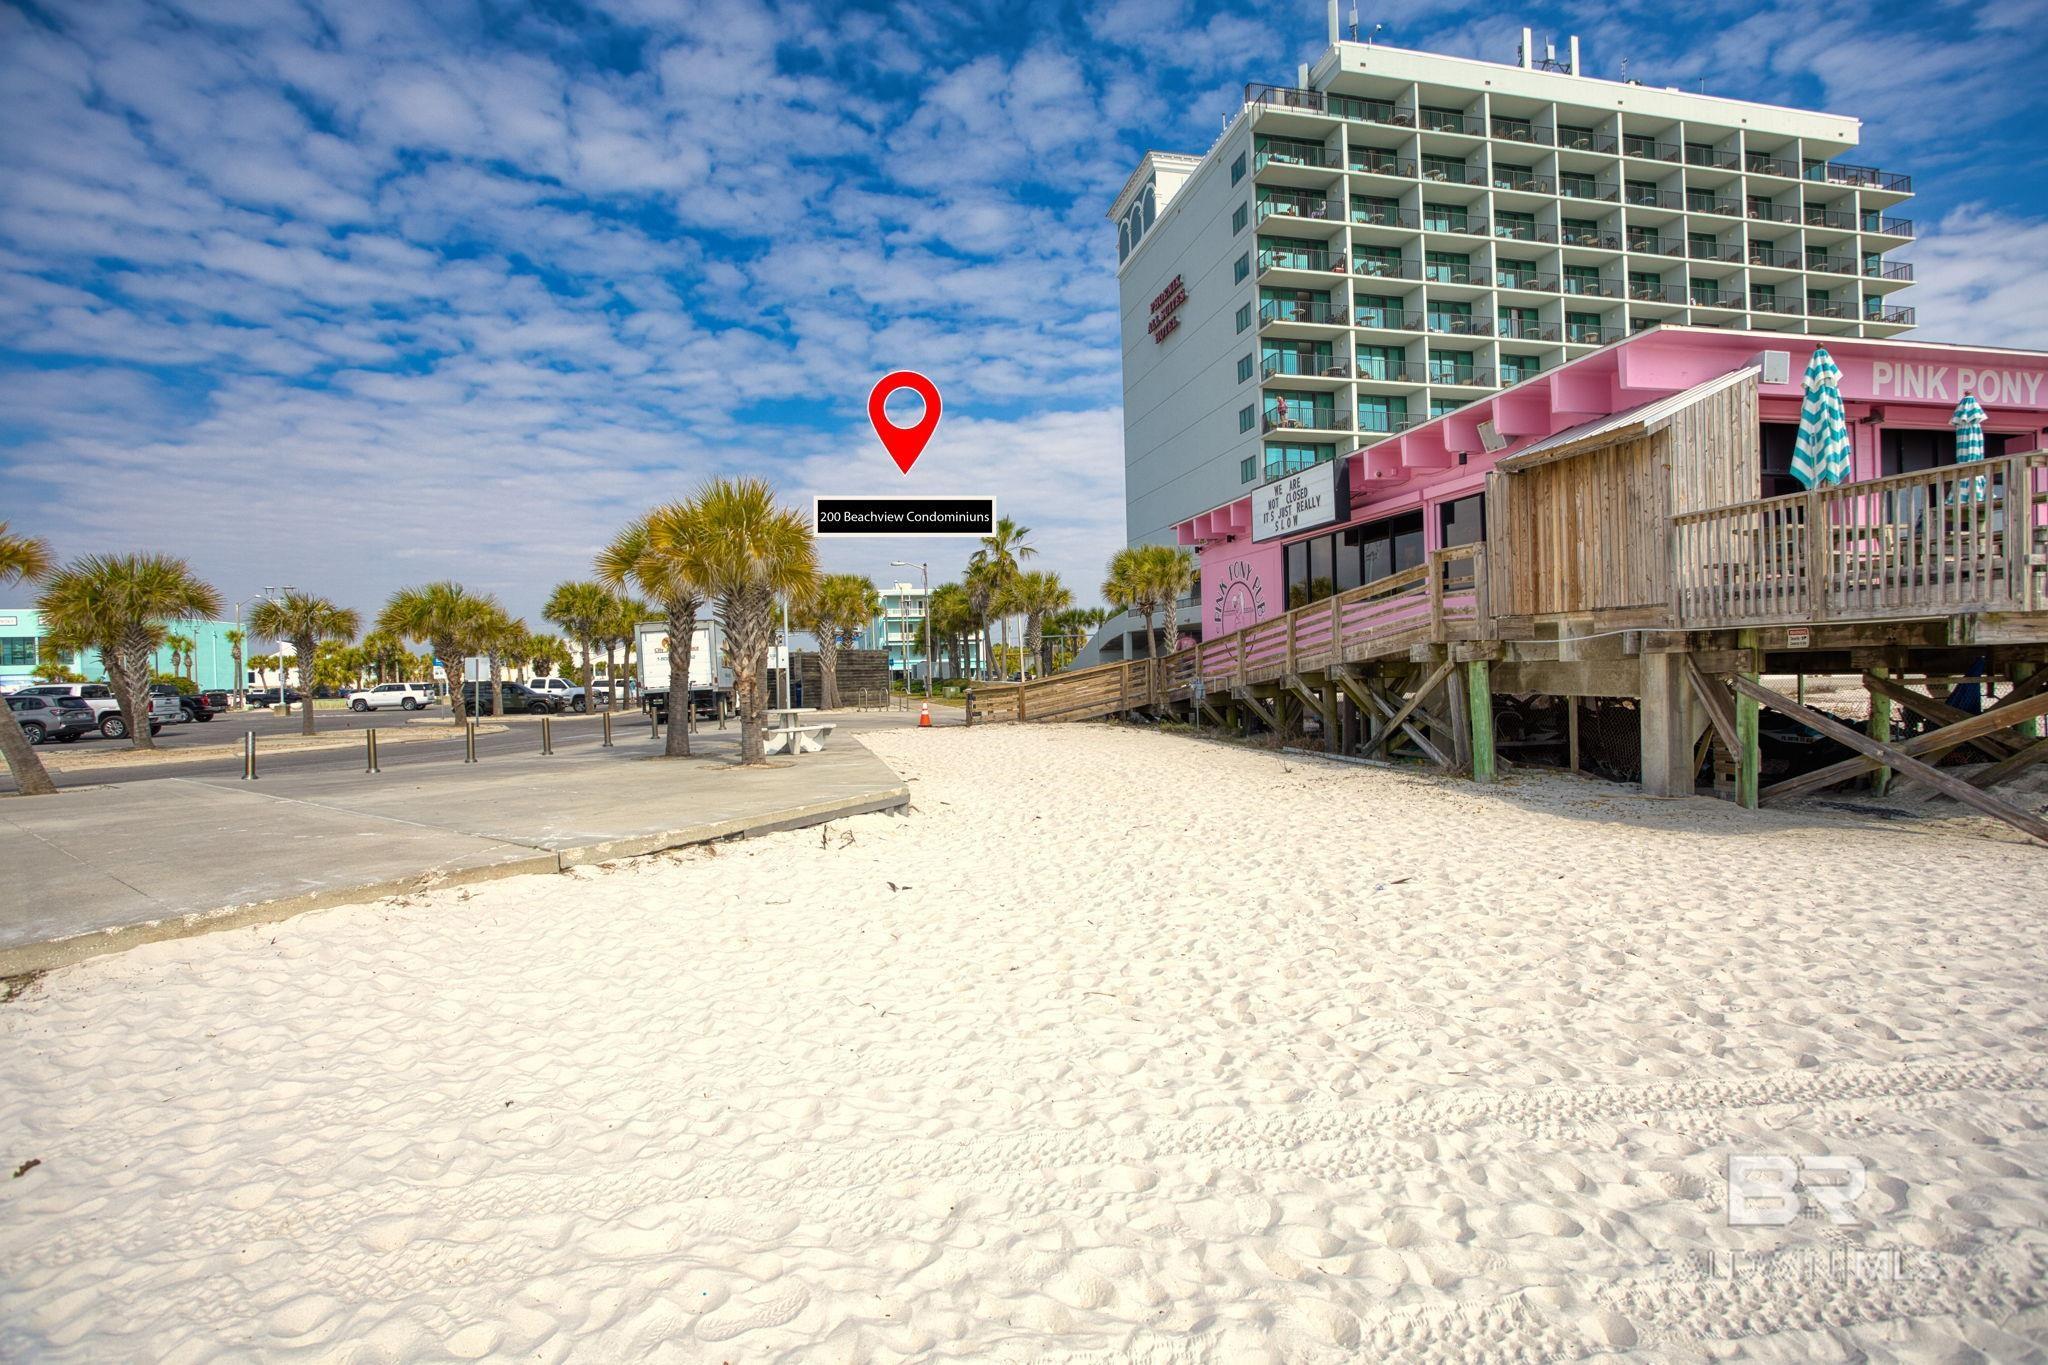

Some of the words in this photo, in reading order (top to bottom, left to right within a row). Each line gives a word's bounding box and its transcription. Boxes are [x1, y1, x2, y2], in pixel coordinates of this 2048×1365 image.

[1872, 361, 1949, 400] PINK
[1957, 367, 2044, 405] PONY
[1267, 497, 1279, 510] NOT
[1285, 487, 1308, 504] CLOSED
[1274, 484, 1283, 496] WE
[1289, 477, 1301, 490] ARE
[1278, 505, 1292, 519] JUST
[1296, 495, 1321, 513] REALLY
[1214, 579, 1227, 622] PINK
[1229, 561, 1254, 581] PONY
[1252, 576, 1265, 617] PUB
